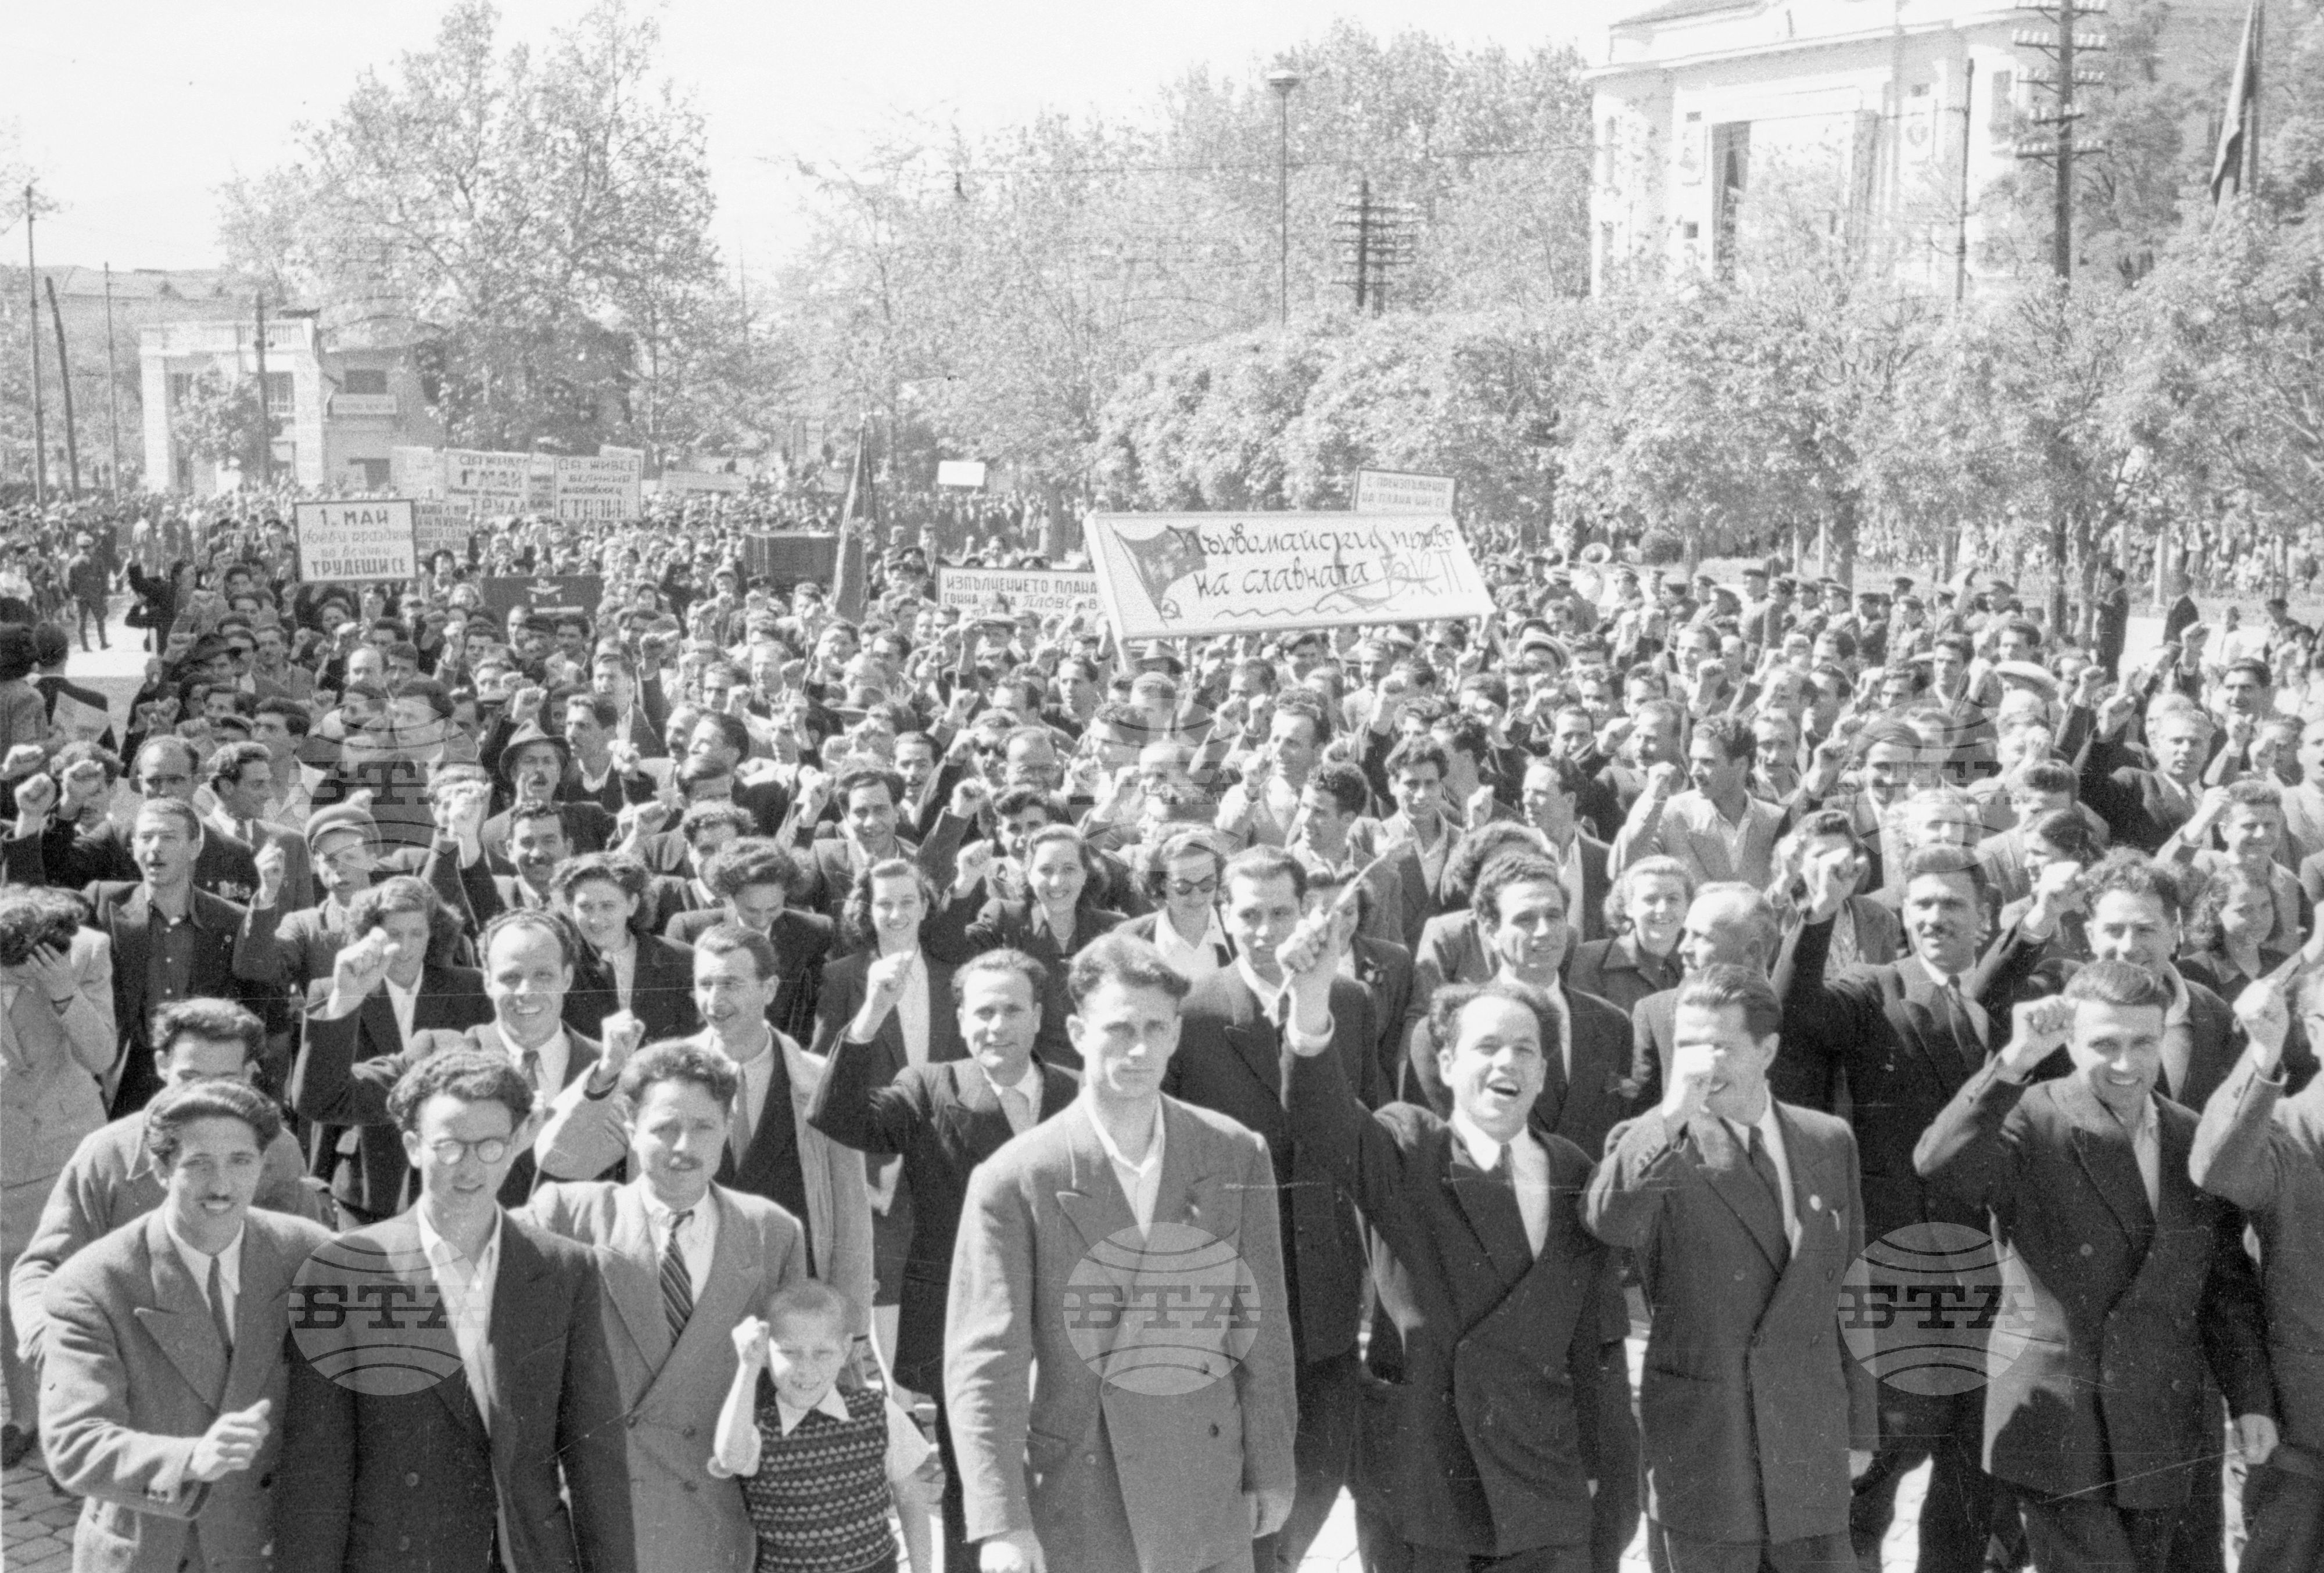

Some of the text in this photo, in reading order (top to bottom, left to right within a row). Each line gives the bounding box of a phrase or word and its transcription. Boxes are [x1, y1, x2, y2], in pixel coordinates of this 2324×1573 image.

[1055, 580, 1098, 593] ПЛАНА
[1193, 572, 1229, 598] на
[1242, 556, 1369, 594] славната
